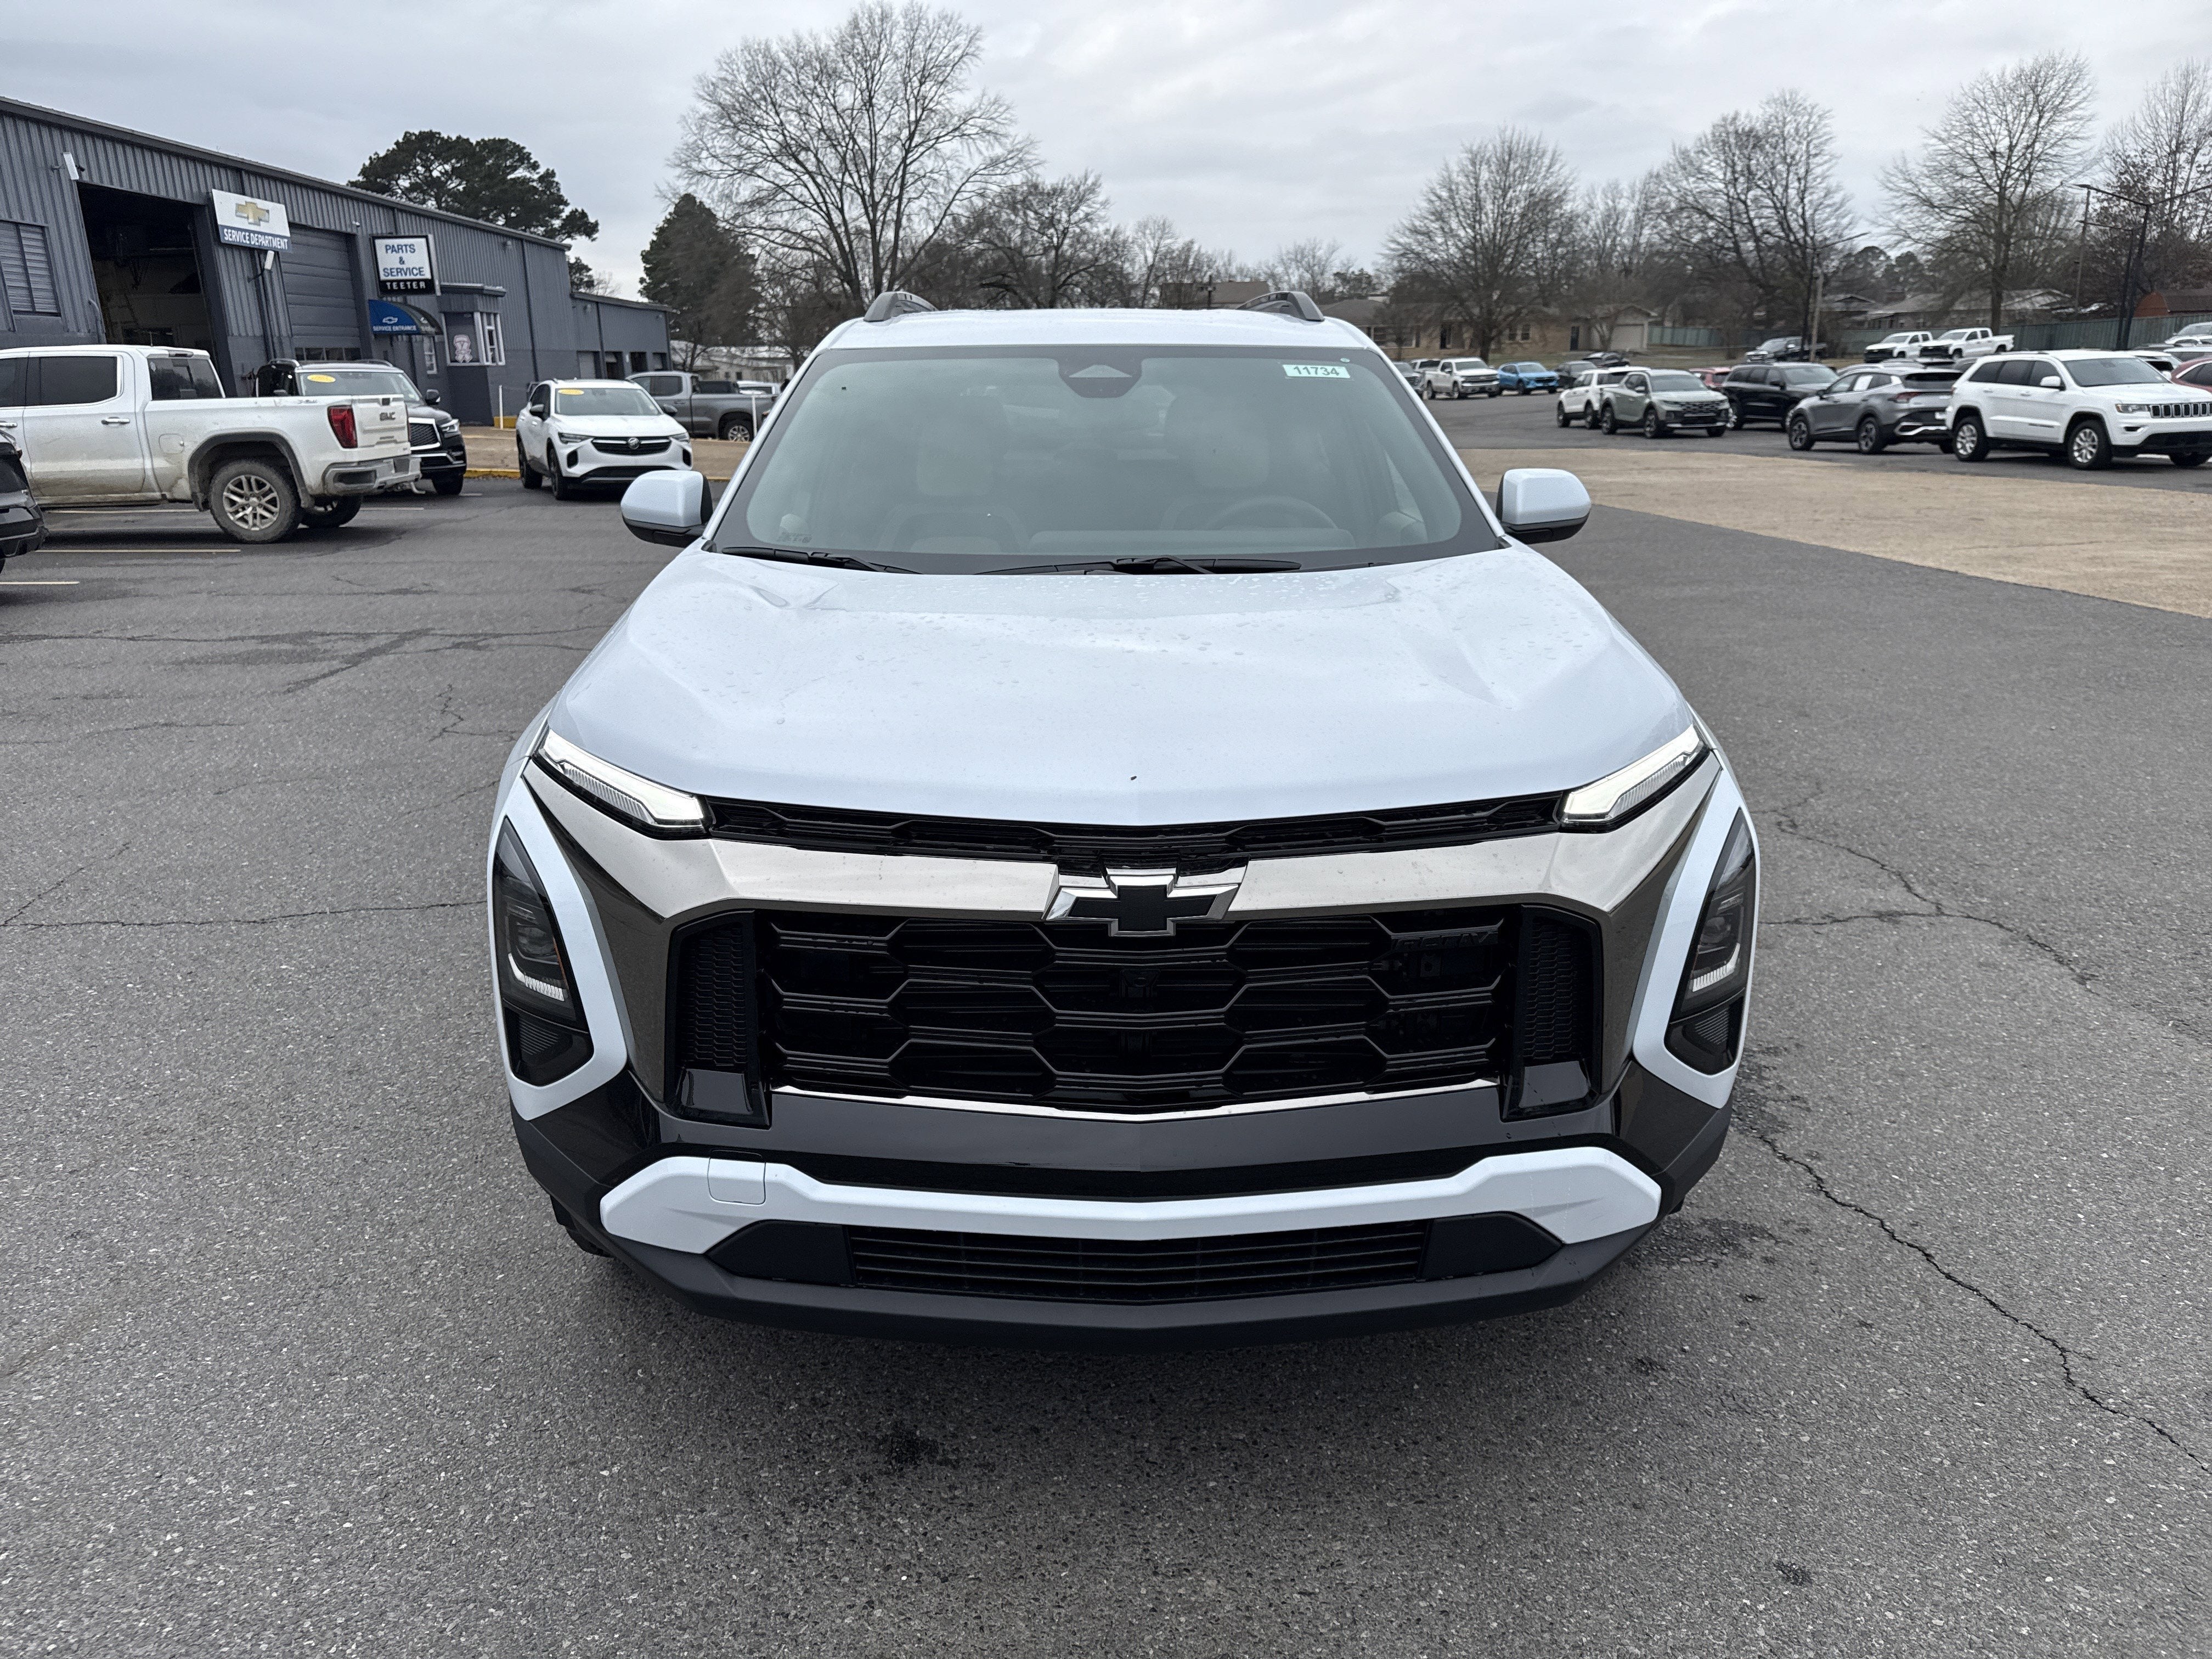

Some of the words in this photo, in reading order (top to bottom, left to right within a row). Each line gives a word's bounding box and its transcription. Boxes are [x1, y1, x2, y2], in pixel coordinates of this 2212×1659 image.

[224, 228, 249, 244] SERVICE
[250, 233, 288, 250] DEPARTMENT
[385, 244, 416, 254] PARTS
[399, 256, 405, 265] &
[382, 266, 425, 278] SERVICE
[386, 281, 426, 290] TEETER
[1294, 366, 1340, 376] 11734
